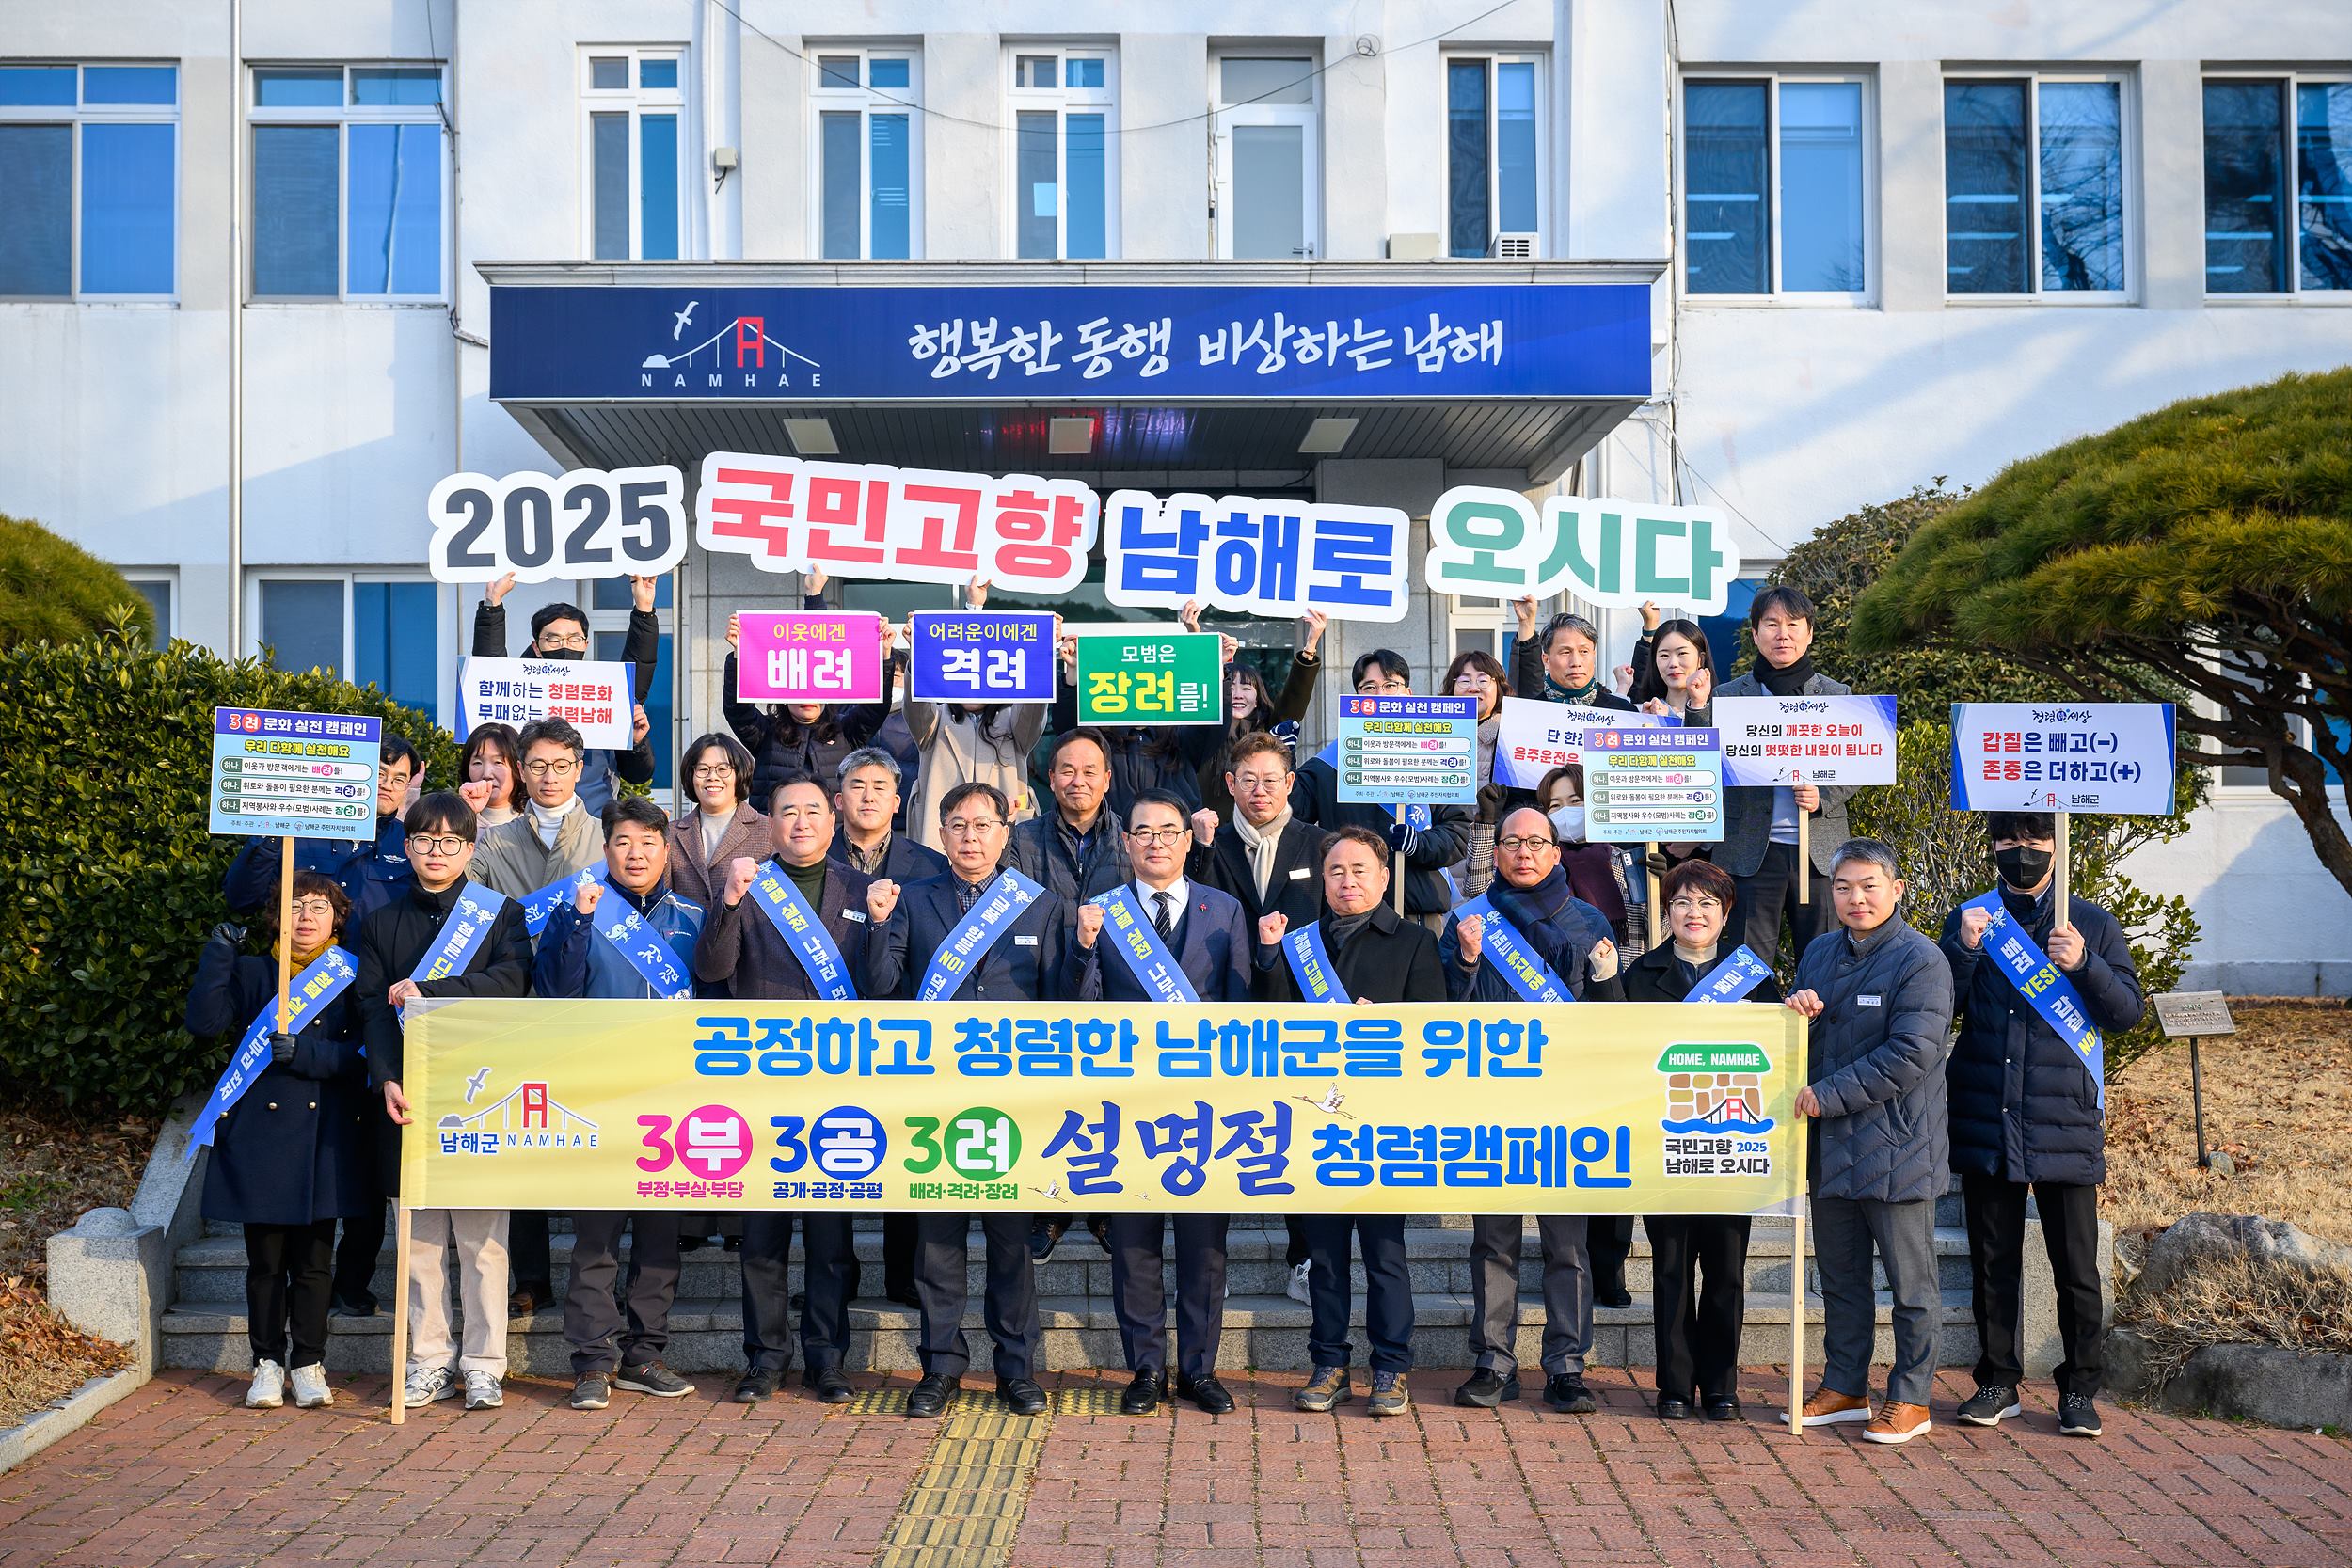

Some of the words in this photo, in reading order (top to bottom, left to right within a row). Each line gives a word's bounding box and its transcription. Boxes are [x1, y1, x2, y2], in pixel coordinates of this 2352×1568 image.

[908, 317, 1063, 379] 행복한
[1071, 317, 1171, 379] 동행
[1199, 312, 1393, 375] 비상하는
[1404, 313, 1503, 373] 남해
[641, 374, 821, 387] NAMHAE
[446, 481, 671, 567] 2025
[712, 468, 1083, 578] 국민고향
[1120, 506, 1393, 606] 남해로
[1442, 502, 1723, 600] 오시다
[773, 623, 846, 641] 이웃에겐
[930, 623, 1037, 642] 어려운이에겐
[1122, 645, 1176, 663] 모범은
[767, 648, 852, 690] 배려
[941, 648, 1025, 691] 격려
[479, 680, 542, 698] 함께하는
[548, 683, 612, 701] 청렴문화
[1089, 671, 1208, 713] 장려를!
[479, 703, 542, 721] 부패없는
[1350, 699, 1375, 713] 3려
[1379, 701, 1402, 712] 문화
[1405, 702, 1427, 713] 실천
[1430, 701, 1465, 714] 캠페인
[228, 713, 259, 731] 3려
[264, 717, 292, 731] 문화
[294, 719, 322, 733] 실천
[325, 720, 367, 736] 캠페인
[1363, 721, 1382, 732] 우리
[1384, 721, 1411, 732] 다함께
[1414, 722, 1451, 733] 실천해요
[1746, 725, 1782, 737] 당신의
[1786, 724, 1823, 737] 깨끗한
[1826, 724, 1863, 736] 오늘이
[1547, 729, 1560, 743] 단
[1594, 733, 1619, 747] 3려
[1623, 734, 1646, 745] 문화
[1648, 734, 1671, 746] 실천
[1674, 733, 1708, 746] 캠페인
[1983, 732, 2042, 753] 갑질은
[2049, 732, 2118, 754] 빼고(-)
[244, 740, 267, 753] 우리
[269, 741, 302, 755] 다함께
[305, 743, 349, 758] 실천해요
[1726, 745, 1761, 757] 당신의
[1765, 744, 1802, 757] 떳떳한
[1805, 744, 1842, 756] 내일이
[1845, 744, 1882, 756] 됩니다
[244, 761, 265, 770] 이웃과
[266, 762, 308, 773] 방문객에게는
[1608, 755, 1627, 766] 우리
[1629, 755, 1656, 766] 다함께
[1659, 755, 1696, 766] 실천해요
[1813, 770, 1835, 778] 남해군
[1983, 760, 2042, 781] 존중은
[2049, 761, 2142, 783] 더하고(+)
[222, 780, 239, 788] 하나.
[243, 781, 263, 790] 위로와
[266, 782, 286, 791] 돌봄이
[288, 784, 309, 793] 필요한
[311, 785, 332, 794] 분께는
[221, 800, 238, 808] 하나.
[241, 801, 276, 811] 지역봉사와
[2071, 794, 2099, 804] 남해군
[760, 876, 788, 904] 청렴
[782, 902, 810, 933] 실천
[802, 936, 838, 982] 나부터
[1109, 900, 1134, 930] 청렴
[1127, 928, 1153, 960] 실천
[443, 921, 475, 960] 청렴은
[1294, 932, 1314, 964] 청렴은
[637, 944, 680, 984] 청렴
[938, 950, 966, 975] NO!
[1506, 949, 1546, 991] 휴지통에
[303, 970, 335, 1000] 청렴
[2001, 937, 2035, 975] 배려
[2020, 963, 2061, 999] YES!
[2050, 995, 2085, 1033] 갑질
[2078, 1026, 2098, 1057] NO!
[693, 1016, 935, 1076] 공정하고
[954, 1017, 1139, 1077] 청렴한
[1156, 1018, 1404, 1077] 남해군을
[1422, 1018, 1549, 1077] 위한
[1669, 1053, 1705, 1066] HOME,
[1711, 1053, 1760, 1065] NAMHAE
[441, 1133, 499, 1154] 남해군
[507, 1135, 597, 1146] NAMHAE
[636, 1114, 743, 1172] 3부
[770, 1116, 876, 1173] 3공
[904, 1116, 1009, 1174] 3려
[1312, 1124, 1632, 1188] 청렴캠페인
[1666, 1139, 1732, 1155] 국민고향
[1736, 1142, 1767, 1153] 2025
[1666, 1158, 1715, 1174] 남해로
[1720, 1158, 1769, 1174] 오시다
[636, 1182, 745, 1199] 부정·부실·부당
[773, 1182, 882, 1200] 공개·공정·공평
[909, 1183, 1018, 1200] 배려·격려·장려
